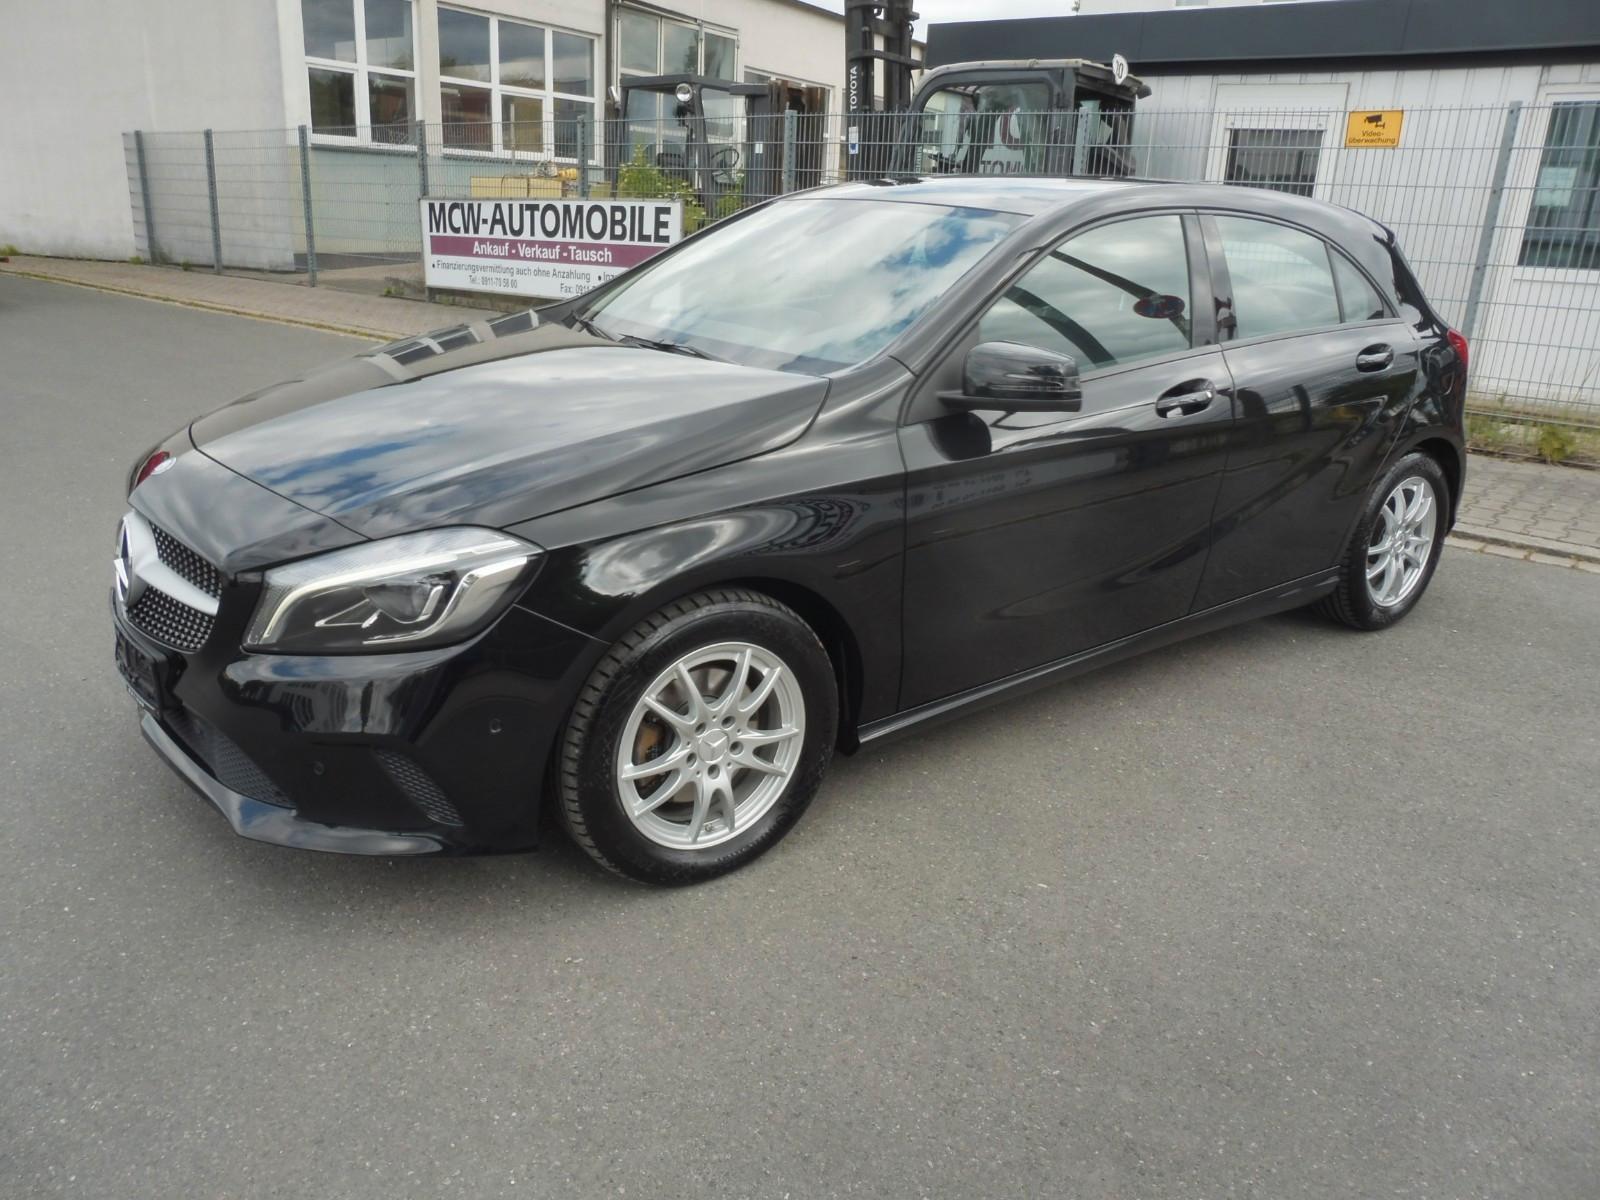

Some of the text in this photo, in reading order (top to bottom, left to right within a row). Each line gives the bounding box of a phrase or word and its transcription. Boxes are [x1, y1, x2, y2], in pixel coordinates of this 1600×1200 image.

[849, 65, 859, 111] TOYOTA
[1348, 136, 1396, 144] überwachung
[428, 202, 671, 243] MCW-AUTOMOBILE
[473, 241, 509, 257] Ankauf
[517, 243, 560, 260] Verkauf
[568, 246, 612, 263] Tausch
[436, 260, 591, 283] Finanzierungsvermittlung auch ohne Anzahlung
[560, 283, 573, 293] Fax:
